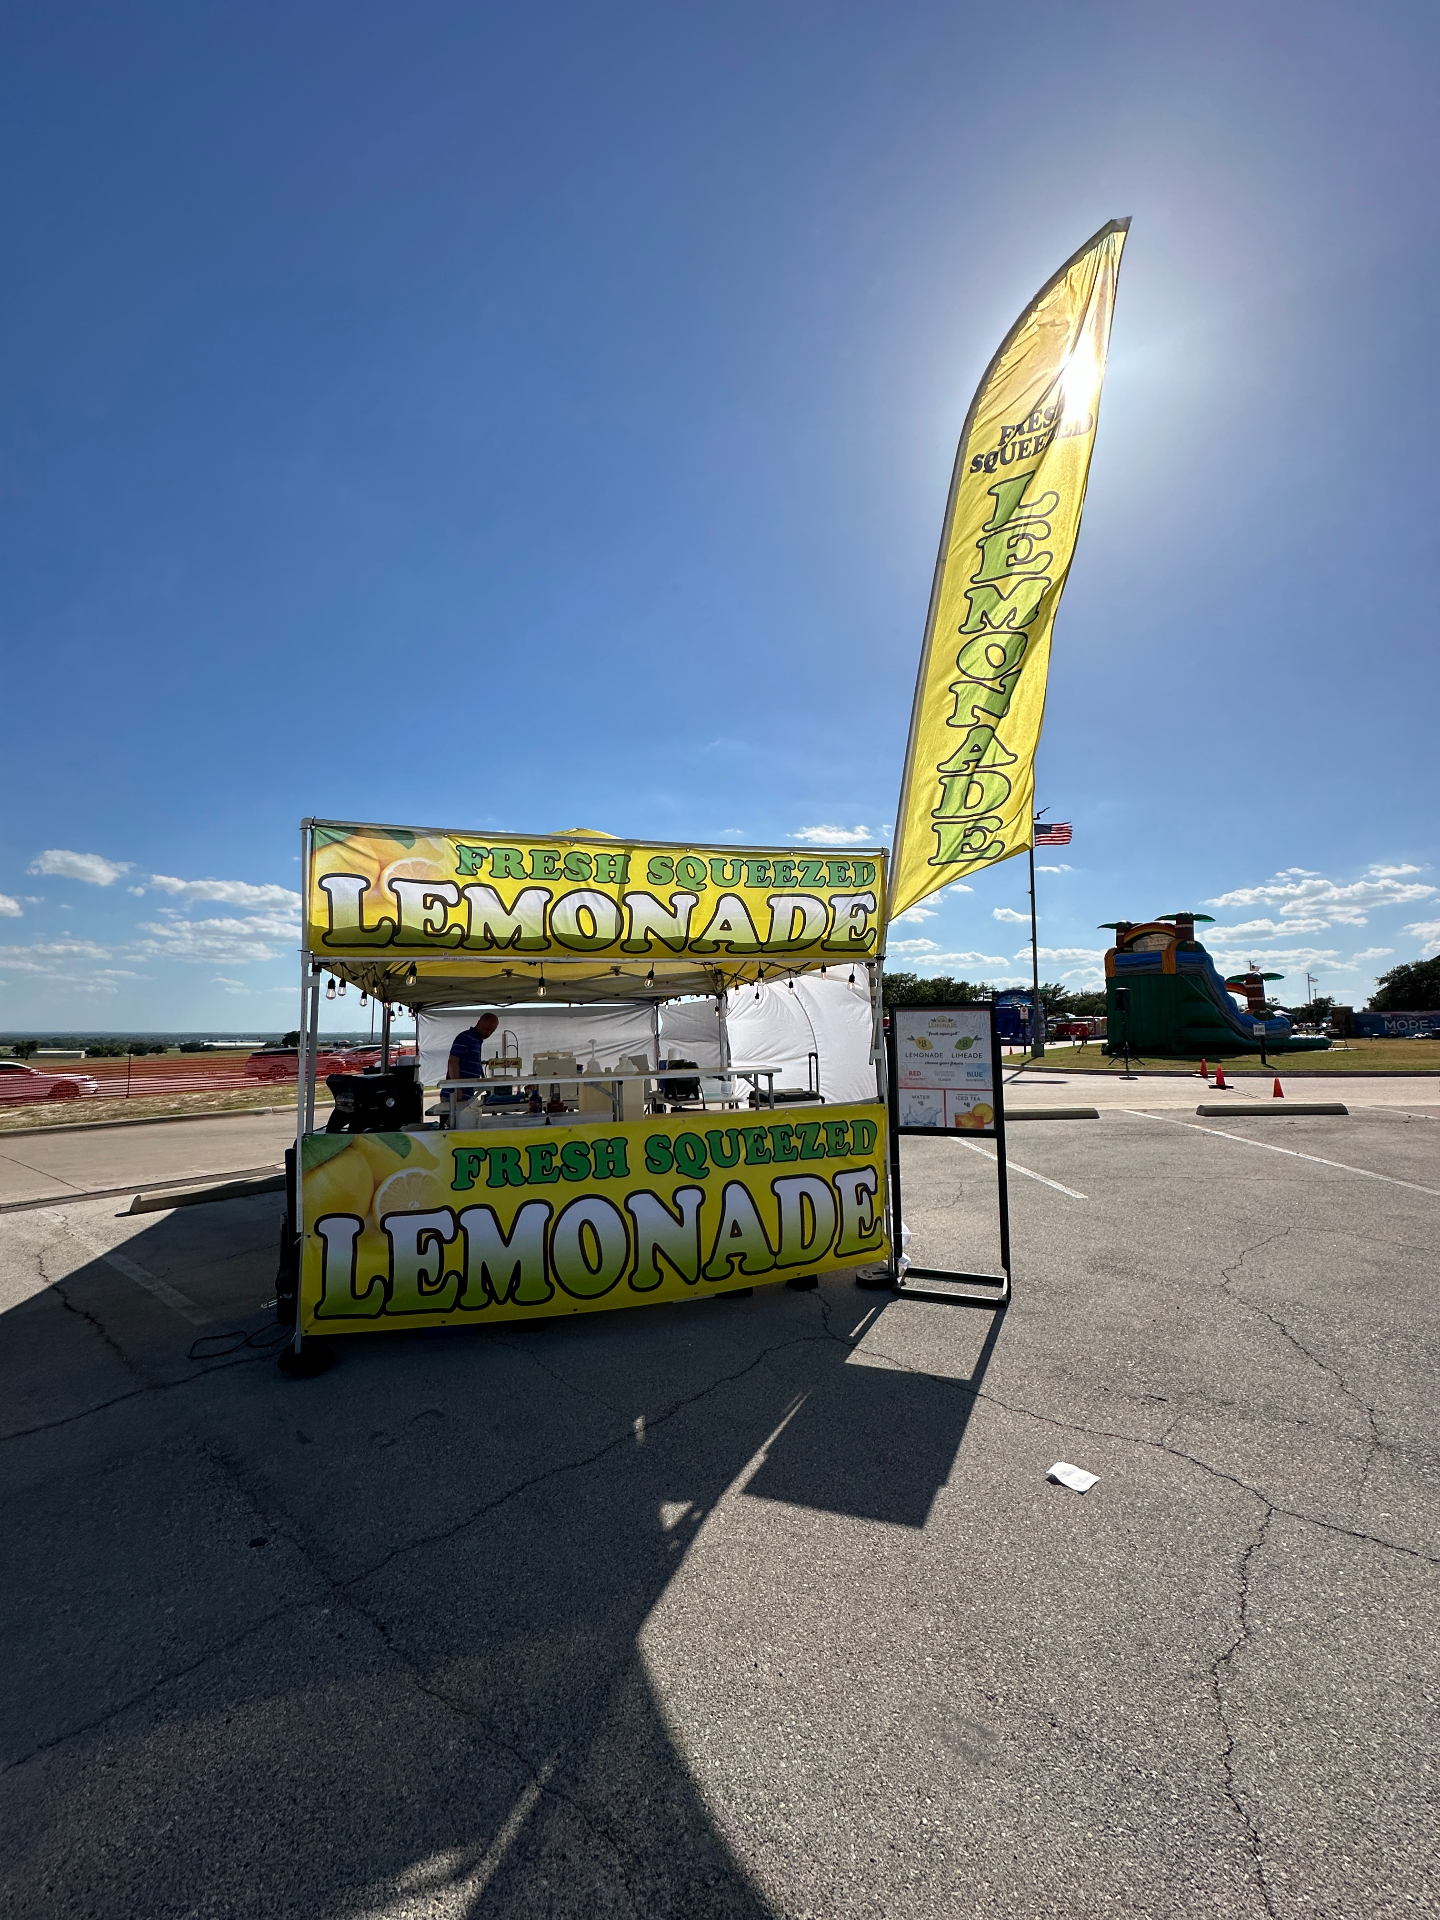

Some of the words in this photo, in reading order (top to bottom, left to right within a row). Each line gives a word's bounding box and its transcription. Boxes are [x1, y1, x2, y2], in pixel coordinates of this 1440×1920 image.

[928, 470, 1059, 866] LEMONADE
[455, 845, 631, 885] FRESH
[646, 854, 876, 892] SQUEEZED
[317, 873, 877, 953] LEMONADE
[918, 1039, 927, 1048] $8
[959, 1039, 968, 1048] $8
[1384, 1020, 1428, 1030] MORE
[451, 1137, 629, 1190] FRESH
[644, 1119, 877, 1179] SQUEEZED
[313, 1166, 884, 1319] LEMONADE
